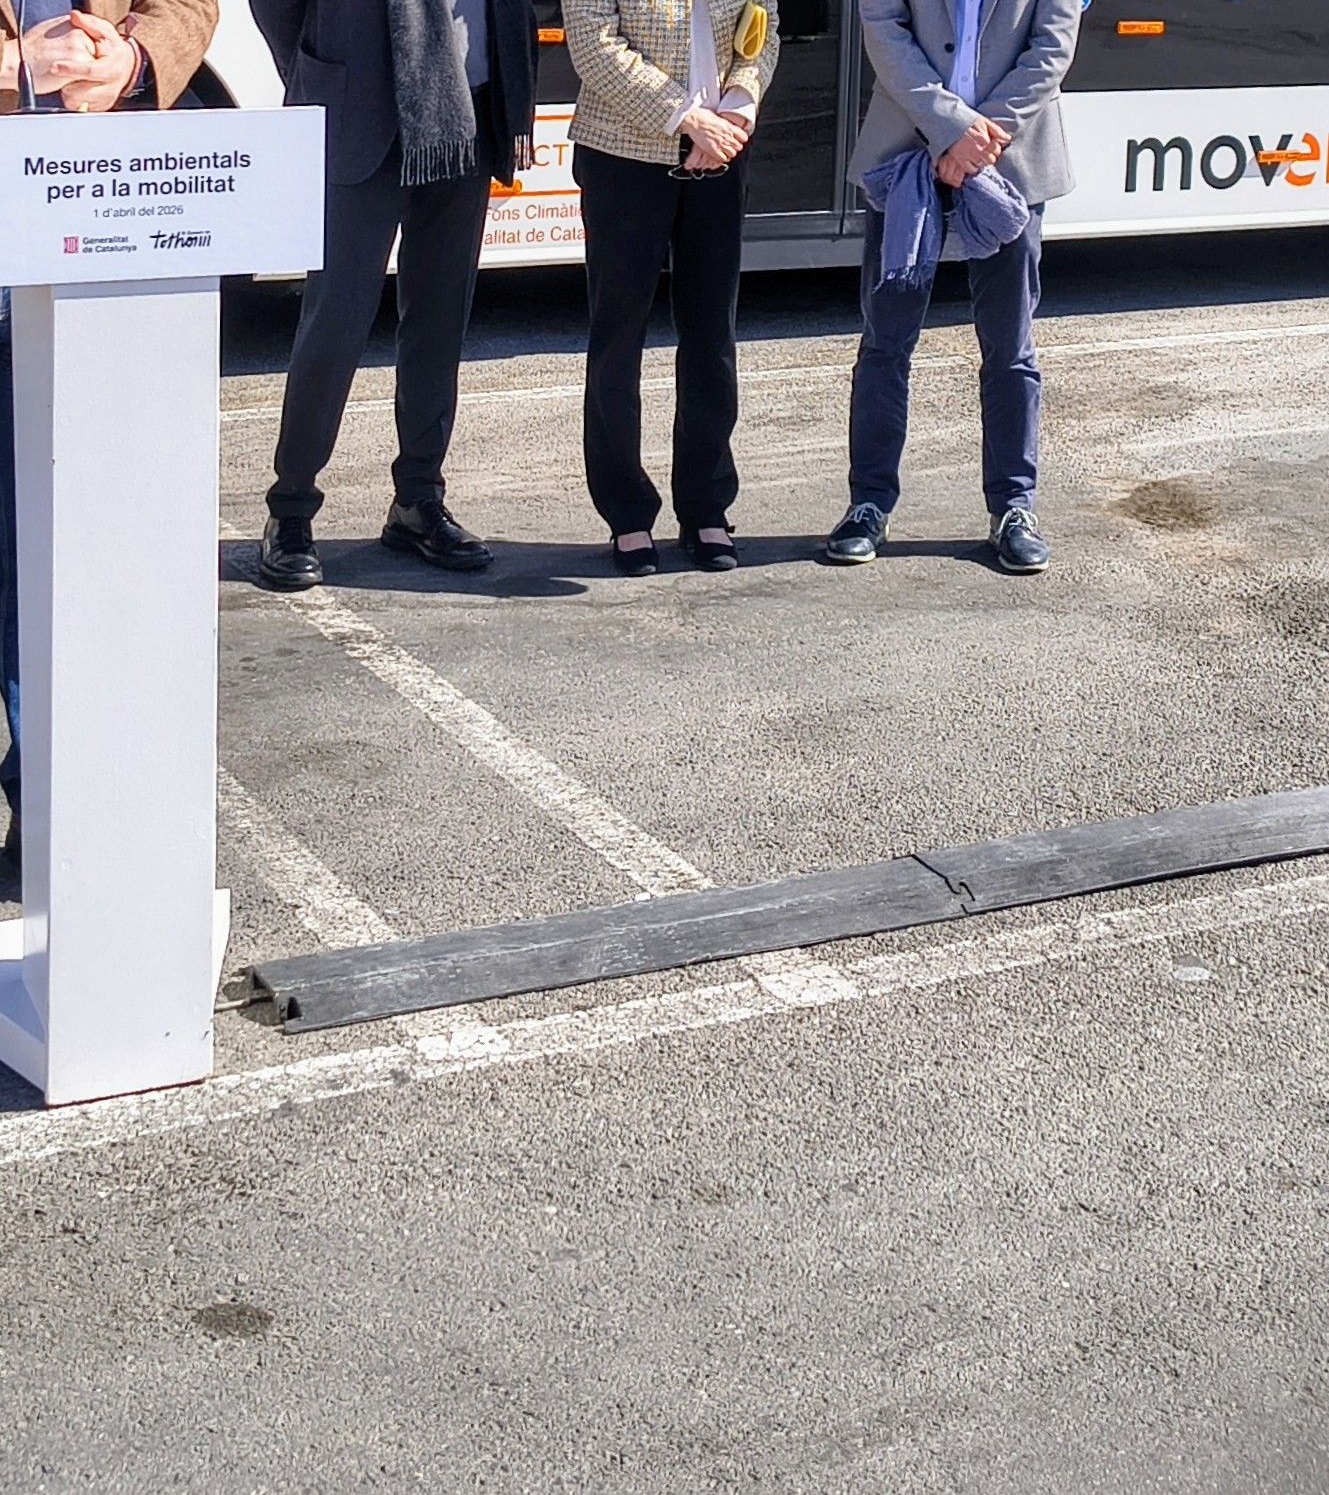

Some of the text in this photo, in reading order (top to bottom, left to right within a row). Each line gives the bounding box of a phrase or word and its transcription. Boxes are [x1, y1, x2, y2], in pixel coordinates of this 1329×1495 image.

[24, 150, 251, 176] Mesures ambientals
[47, 175, 236, 204] per a la mobilitat
[93, 205, 184, 218] 1 d'abril del 2026
[82, 236, 129, 245] Generalitat
[484, 229, 521, 245] alitat
[526, 227, 545, 243] de
[95, 245, 137, 254] Catalunya
